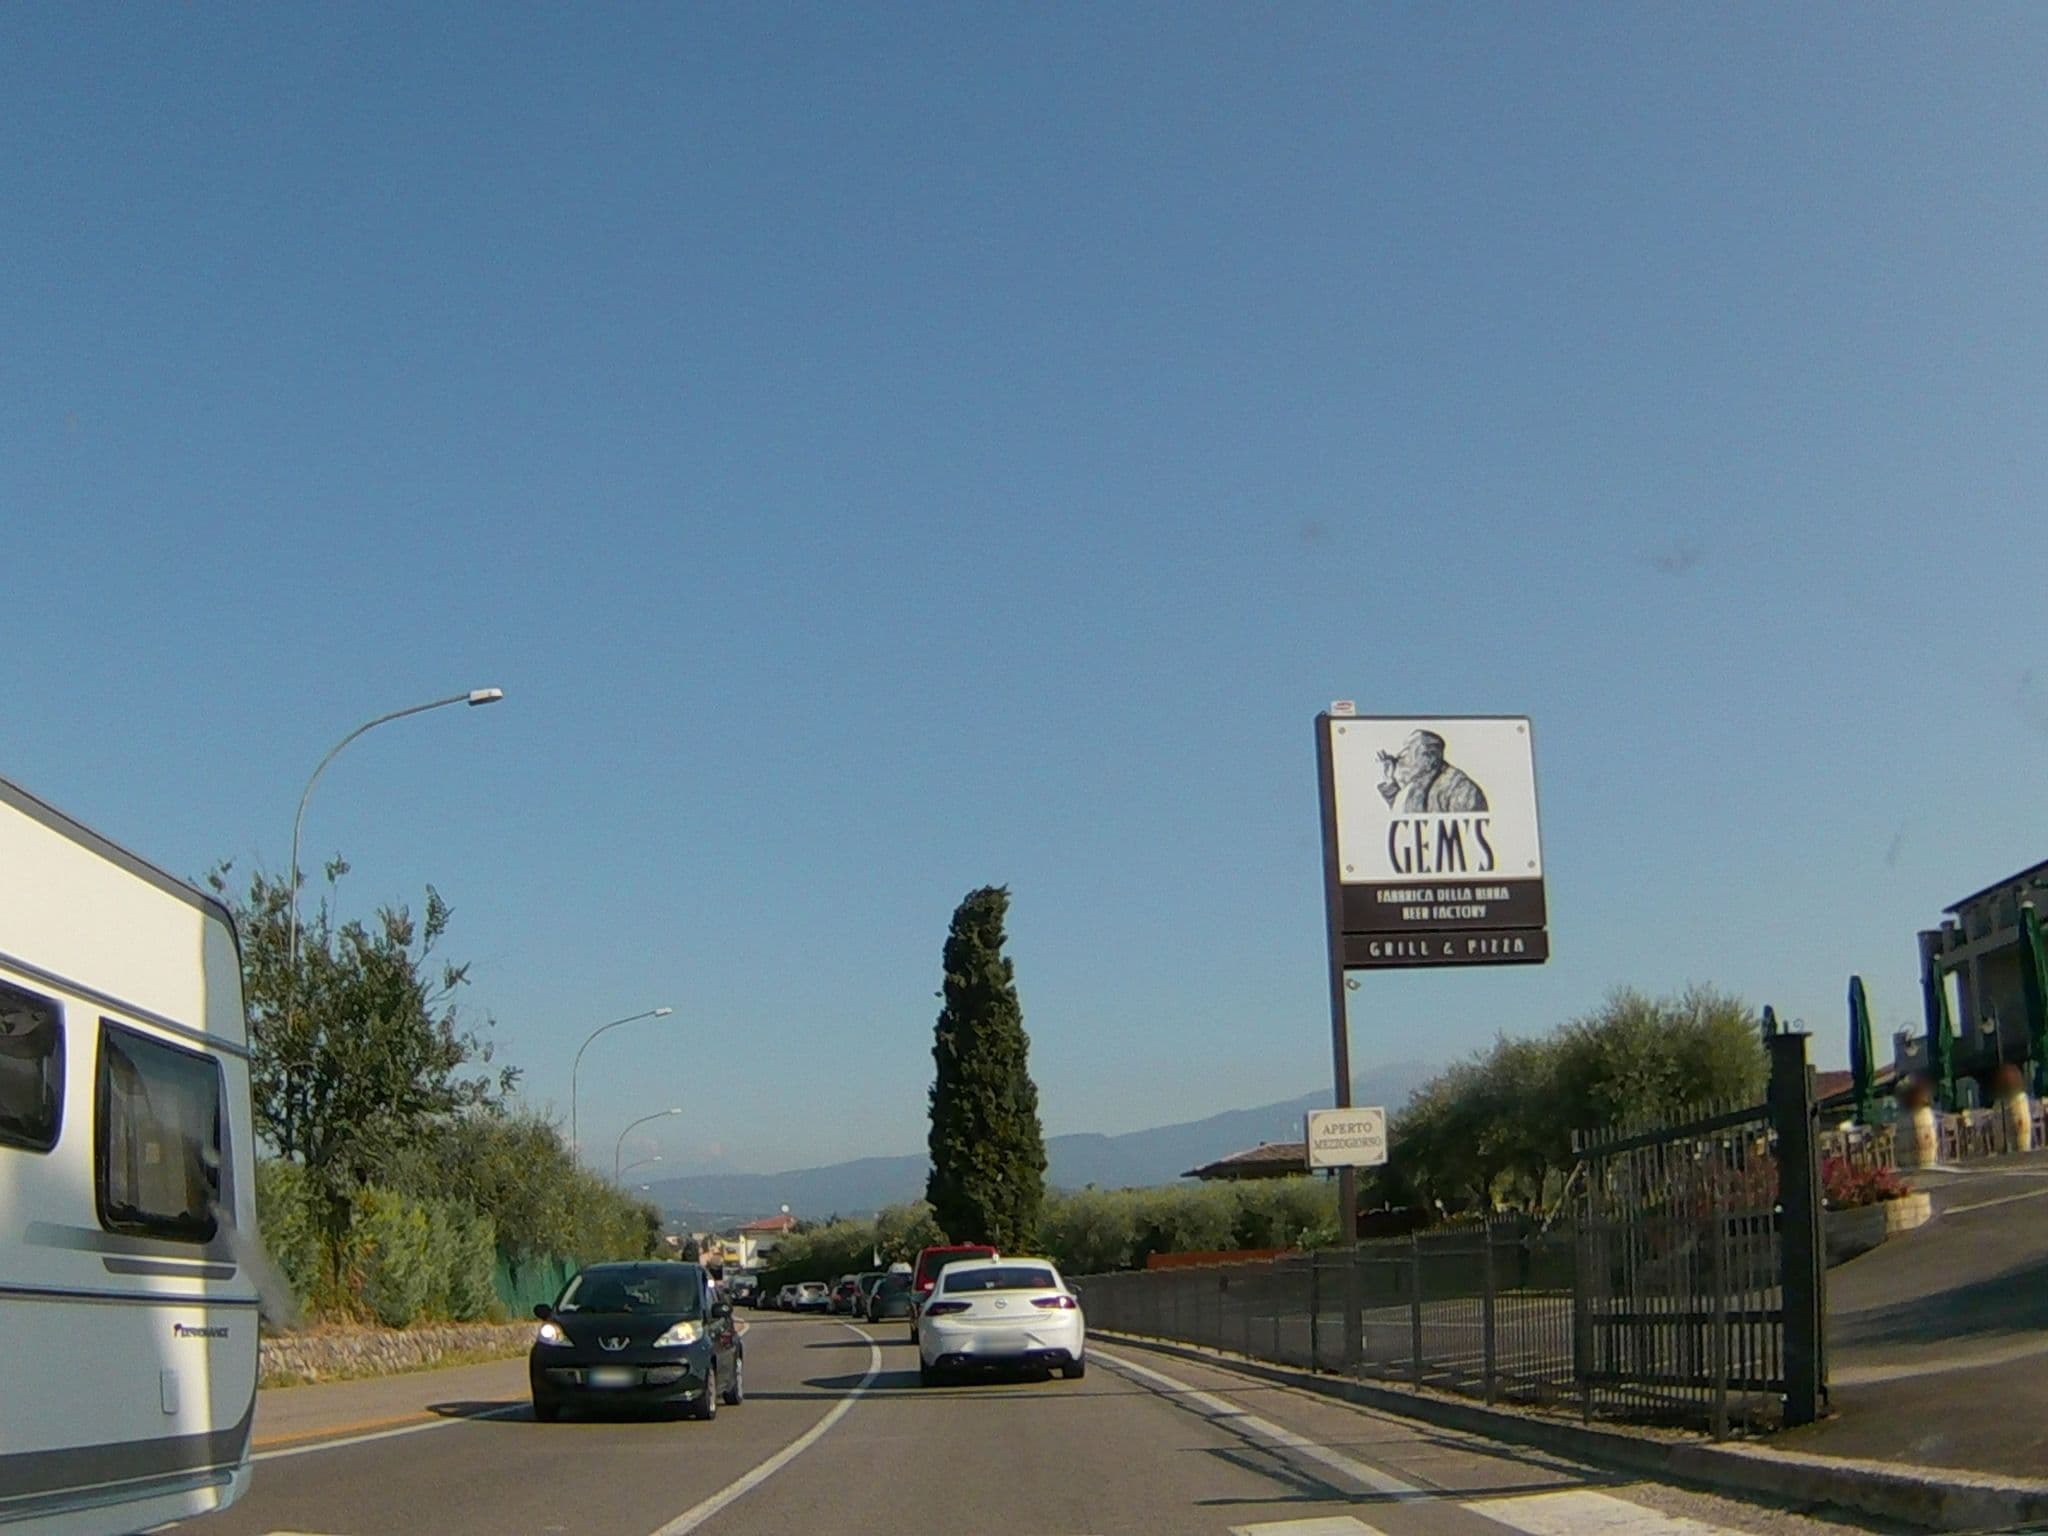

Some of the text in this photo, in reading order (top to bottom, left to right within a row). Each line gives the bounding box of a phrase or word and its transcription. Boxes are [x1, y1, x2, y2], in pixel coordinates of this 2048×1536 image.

[1388, 818, 1495, 874] GEM'S
[1437, 887, 1472, 901] DELLA
[1475, 886, 1509, 900] BIRRA
[1402, 905, 1487, 920] BEER FACTORY
[1369, 938, 1524, 957] GRILL & PIZZA
[1323, 1122, 1373, 1135] APERTO
